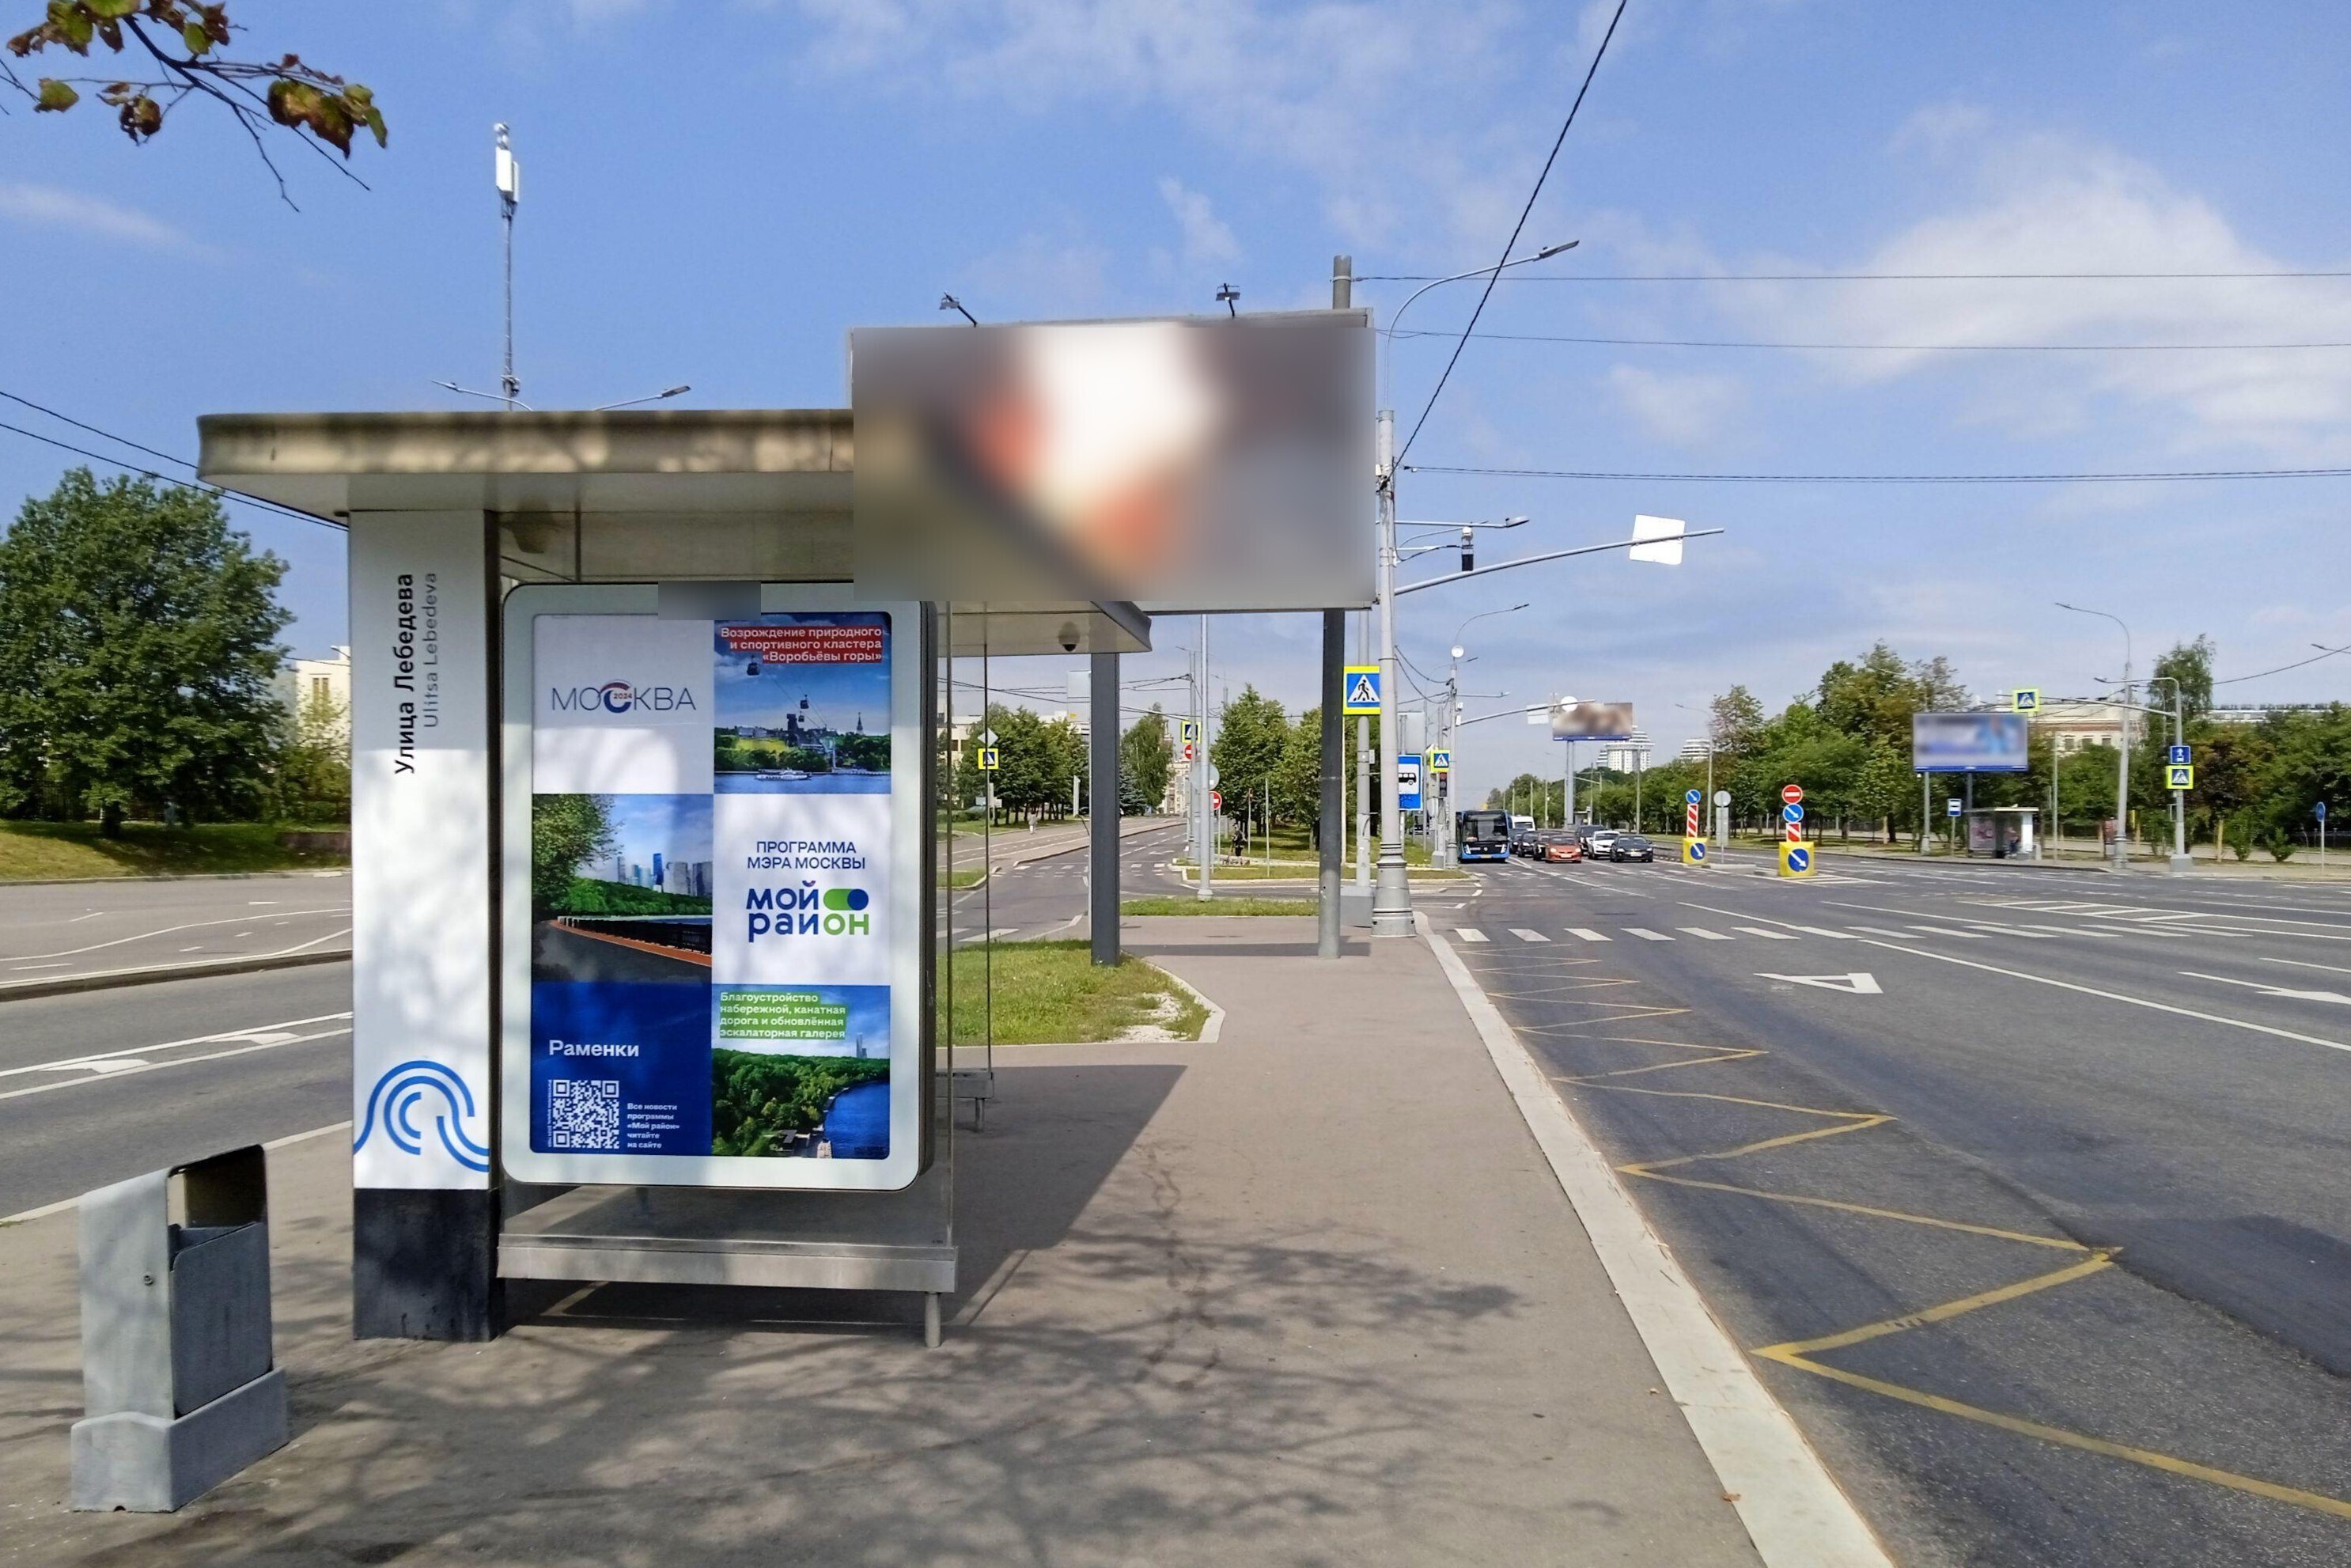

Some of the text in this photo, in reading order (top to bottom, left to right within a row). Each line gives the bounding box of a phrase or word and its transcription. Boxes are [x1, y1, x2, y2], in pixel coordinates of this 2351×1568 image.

[721, 627, 882, 639] Возрождение природного
[421, 572, 439, 728] Ulitsa Lebedeva
[740, 641, 821, 651] спортивного
[823, 640, 883, 651] кластера
[762, 651, 883, 663] «Воробьёвы горы»
[393, 574, 418, 774] Улица Лебедева
[551, 680, 696, 714] МОСКВА
[756, 841, 857, 854] ПРОГРАММА
[747, 857, 865, 869] МЭРА МОСКВЫ
[720, 991, 819, 1004] Благоустройство
[720, 1004, 846, 1015] набережной, канатная
[720, 1017, 759, 1027] дорога
[770, 1016, 844, 1026] обновлённая
[720, 1028, 846, 1040] эскалаторная галерея
[549, 1039, 640, 1057] Раменки
